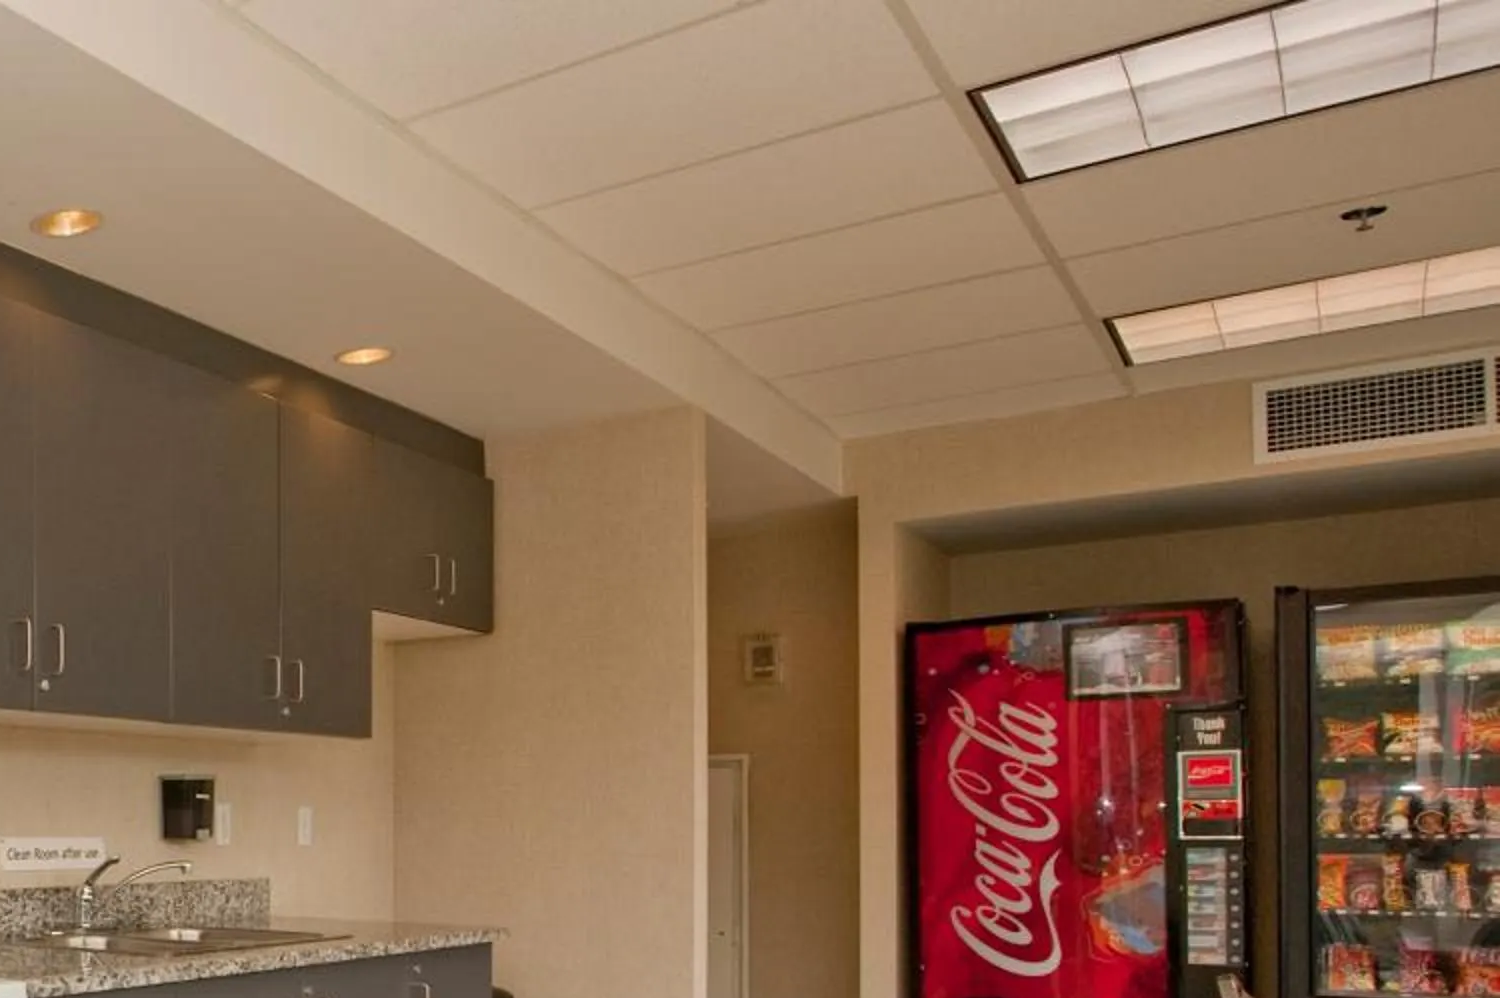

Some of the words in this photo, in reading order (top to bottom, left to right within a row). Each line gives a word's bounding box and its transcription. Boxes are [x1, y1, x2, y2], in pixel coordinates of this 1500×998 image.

[1193, 717, 1226, 731] Thank
[7, 847, 31, 861] Clean
[34, 847, 59, 861] Room
